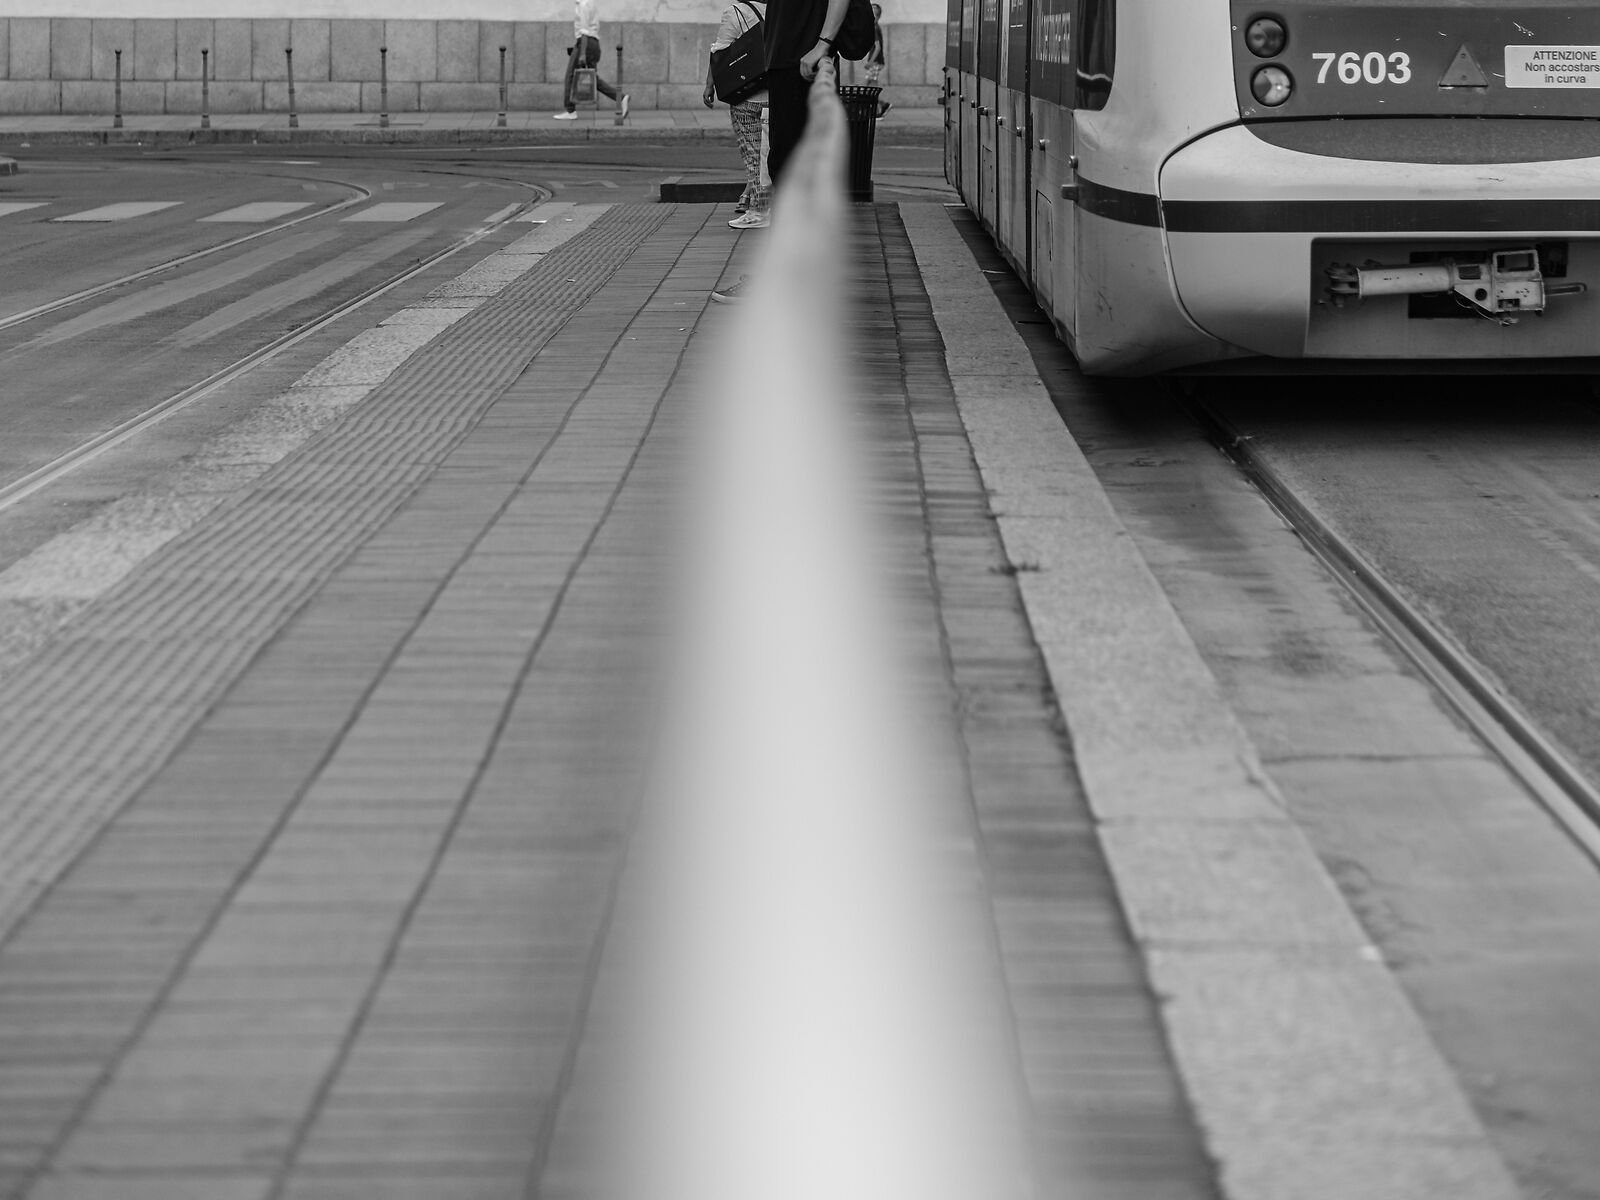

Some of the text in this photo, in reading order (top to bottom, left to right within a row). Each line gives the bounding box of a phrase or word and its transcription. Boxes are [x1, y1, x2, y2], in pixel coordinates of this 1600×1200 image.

[1533, 51, 1597, 60] ATTENZIONE
[1312, 52, 1412, 85] 7603
[1525, 62, 1600, 72] Non accostars
[1544, 74, 1586, 84] in curva
